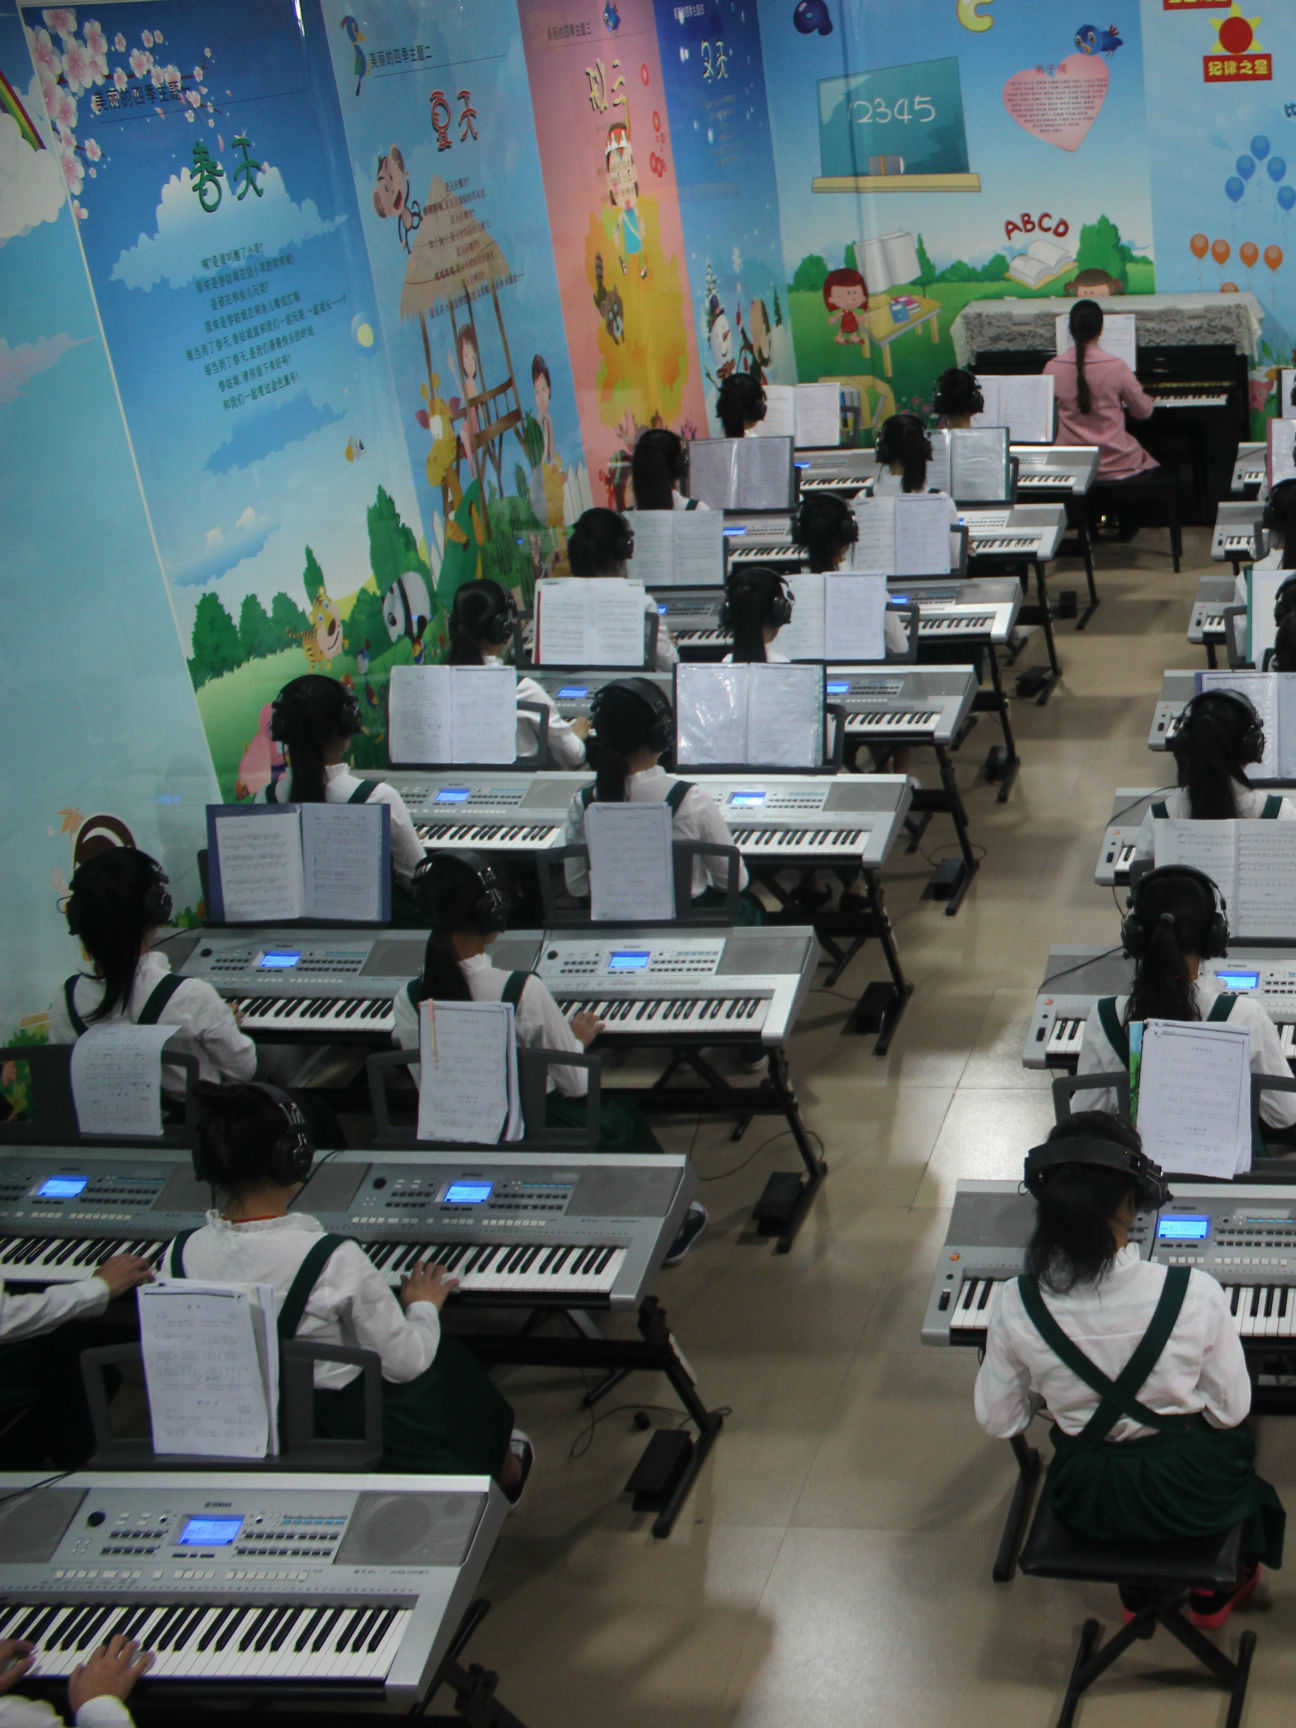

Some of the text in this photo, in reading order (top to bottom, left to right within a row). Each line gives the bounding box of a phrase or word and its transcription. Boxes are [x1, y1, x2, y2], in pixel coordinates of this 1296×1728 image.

[369, 45, 433, 69] 美丽的四季主题二
[1207, 59, 1269, 76] 纪律之星
[190, 137, 264, 213] 春天
[1005, 212, 1069, 241] ABCD
